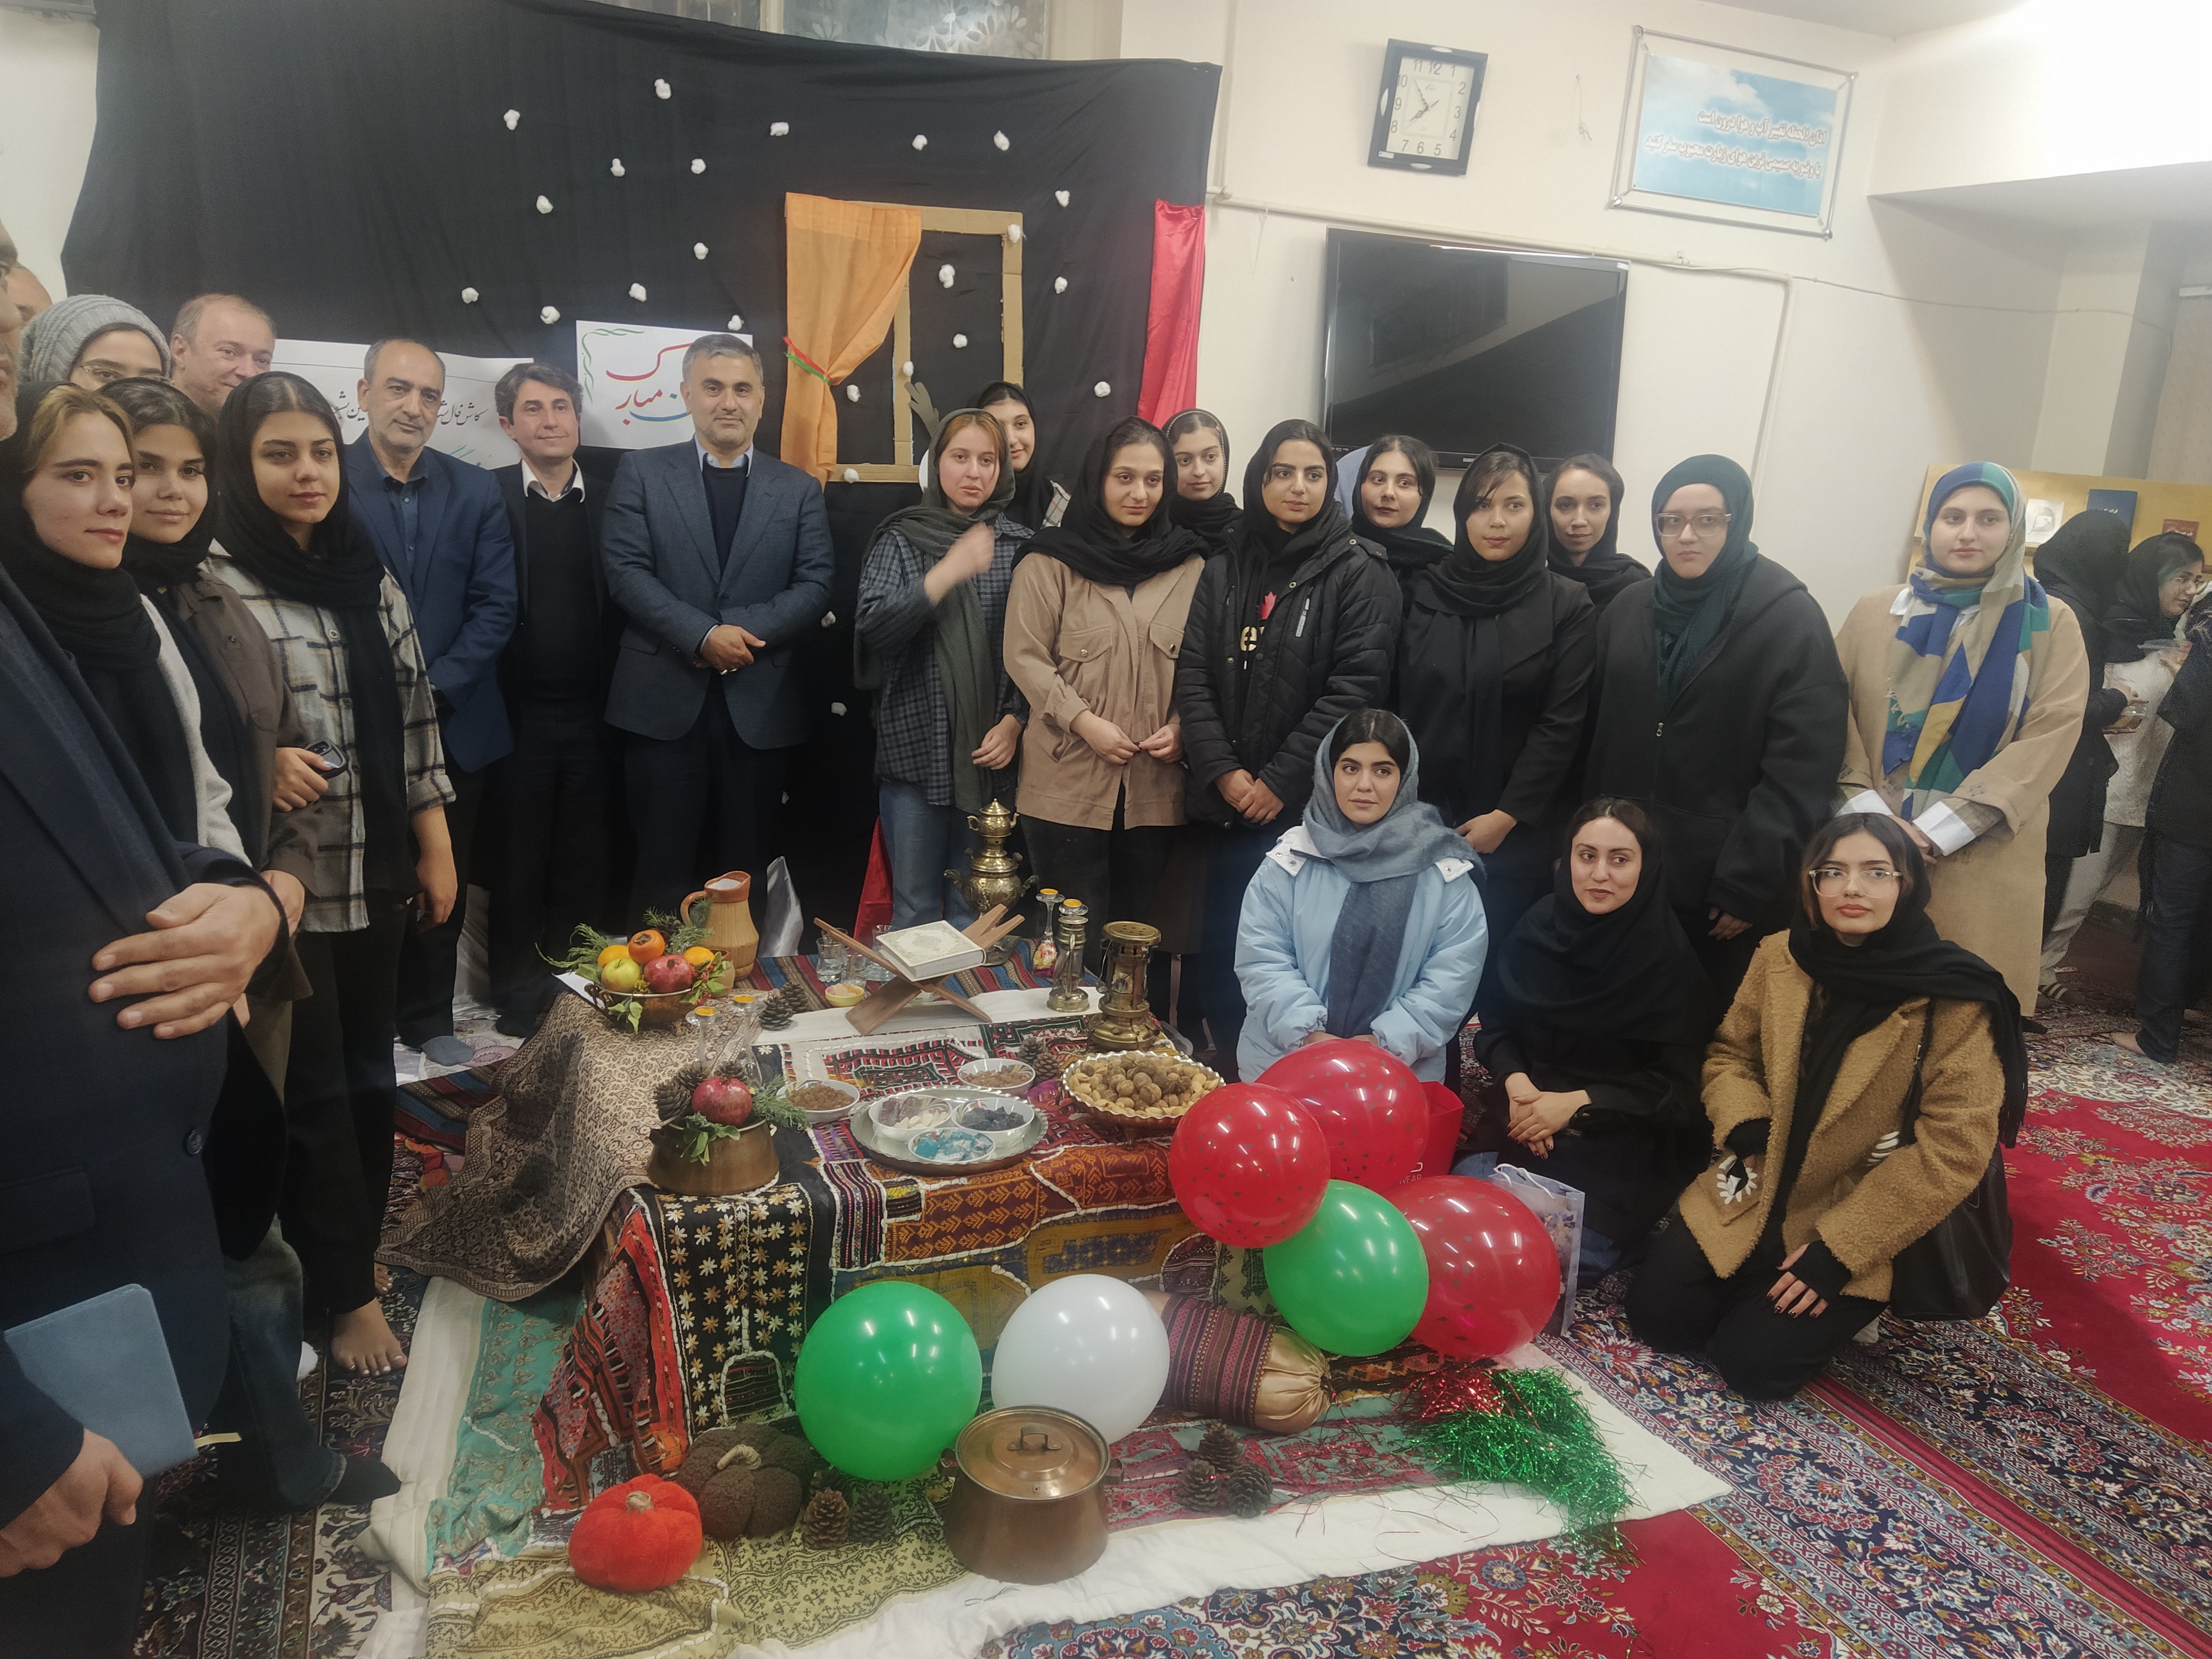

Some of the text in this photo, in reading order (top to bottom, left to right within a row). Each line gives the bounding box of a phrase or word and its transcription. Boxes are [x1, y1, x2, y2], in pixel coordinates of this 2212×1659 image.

[1413, 59, 1423, 72] 11
[1428, 62, 1442, 75] 12
[1451, 64, 1456, 77] 1
[1397, 74, 1408, 88] 10
[1458, 81, 1467, 95] 2
[1394, 97, 1402, 111] 9
[1453, 106, 1462, 119] 3
[1697, 109, 1716, 125] است
[1390, 120, 1399, 133] 8
[1715, 116, 1736, 132] درون
[1736, 114, 1750, 134] هوا
[1748, 122, 1755, 136] و
[1755, 118, 1770, 137] آب
[1449, 128, 1457, 142] 4
[1401, 139, 1410, 152] 7
[1416, 141, 1425, 154] 6
[1433, 143, 1442, 156] 5
[1662, 136, 1678, 154] سفر
[1704, 144, 1728, 165] زیارت
[1815, 161, 1822, 179] با
